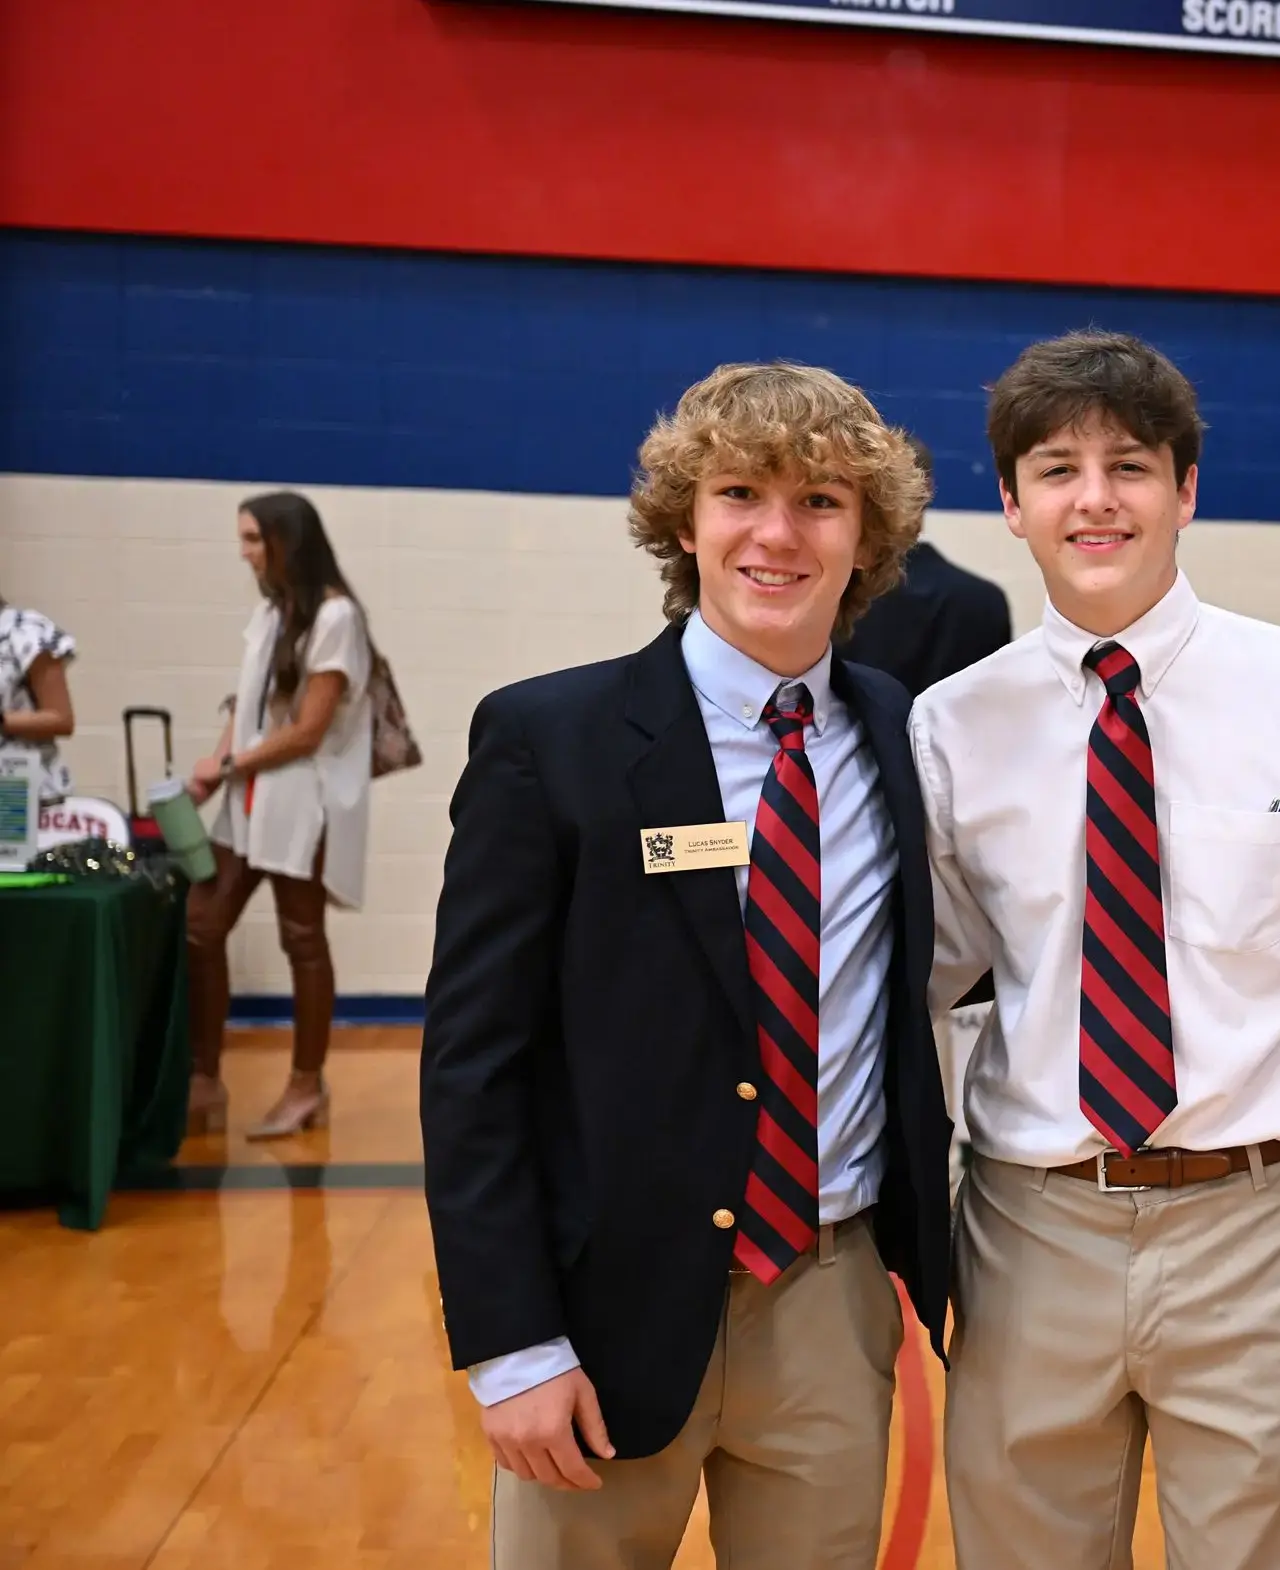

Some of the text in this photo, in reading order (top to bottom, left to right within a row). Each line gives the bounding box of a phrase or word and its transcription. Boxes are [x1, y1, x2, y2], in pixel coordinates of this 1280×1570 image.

[688, 838, 734, 848] LUCAS SNYDER
[649, 860, 676, 869] TRINITY
